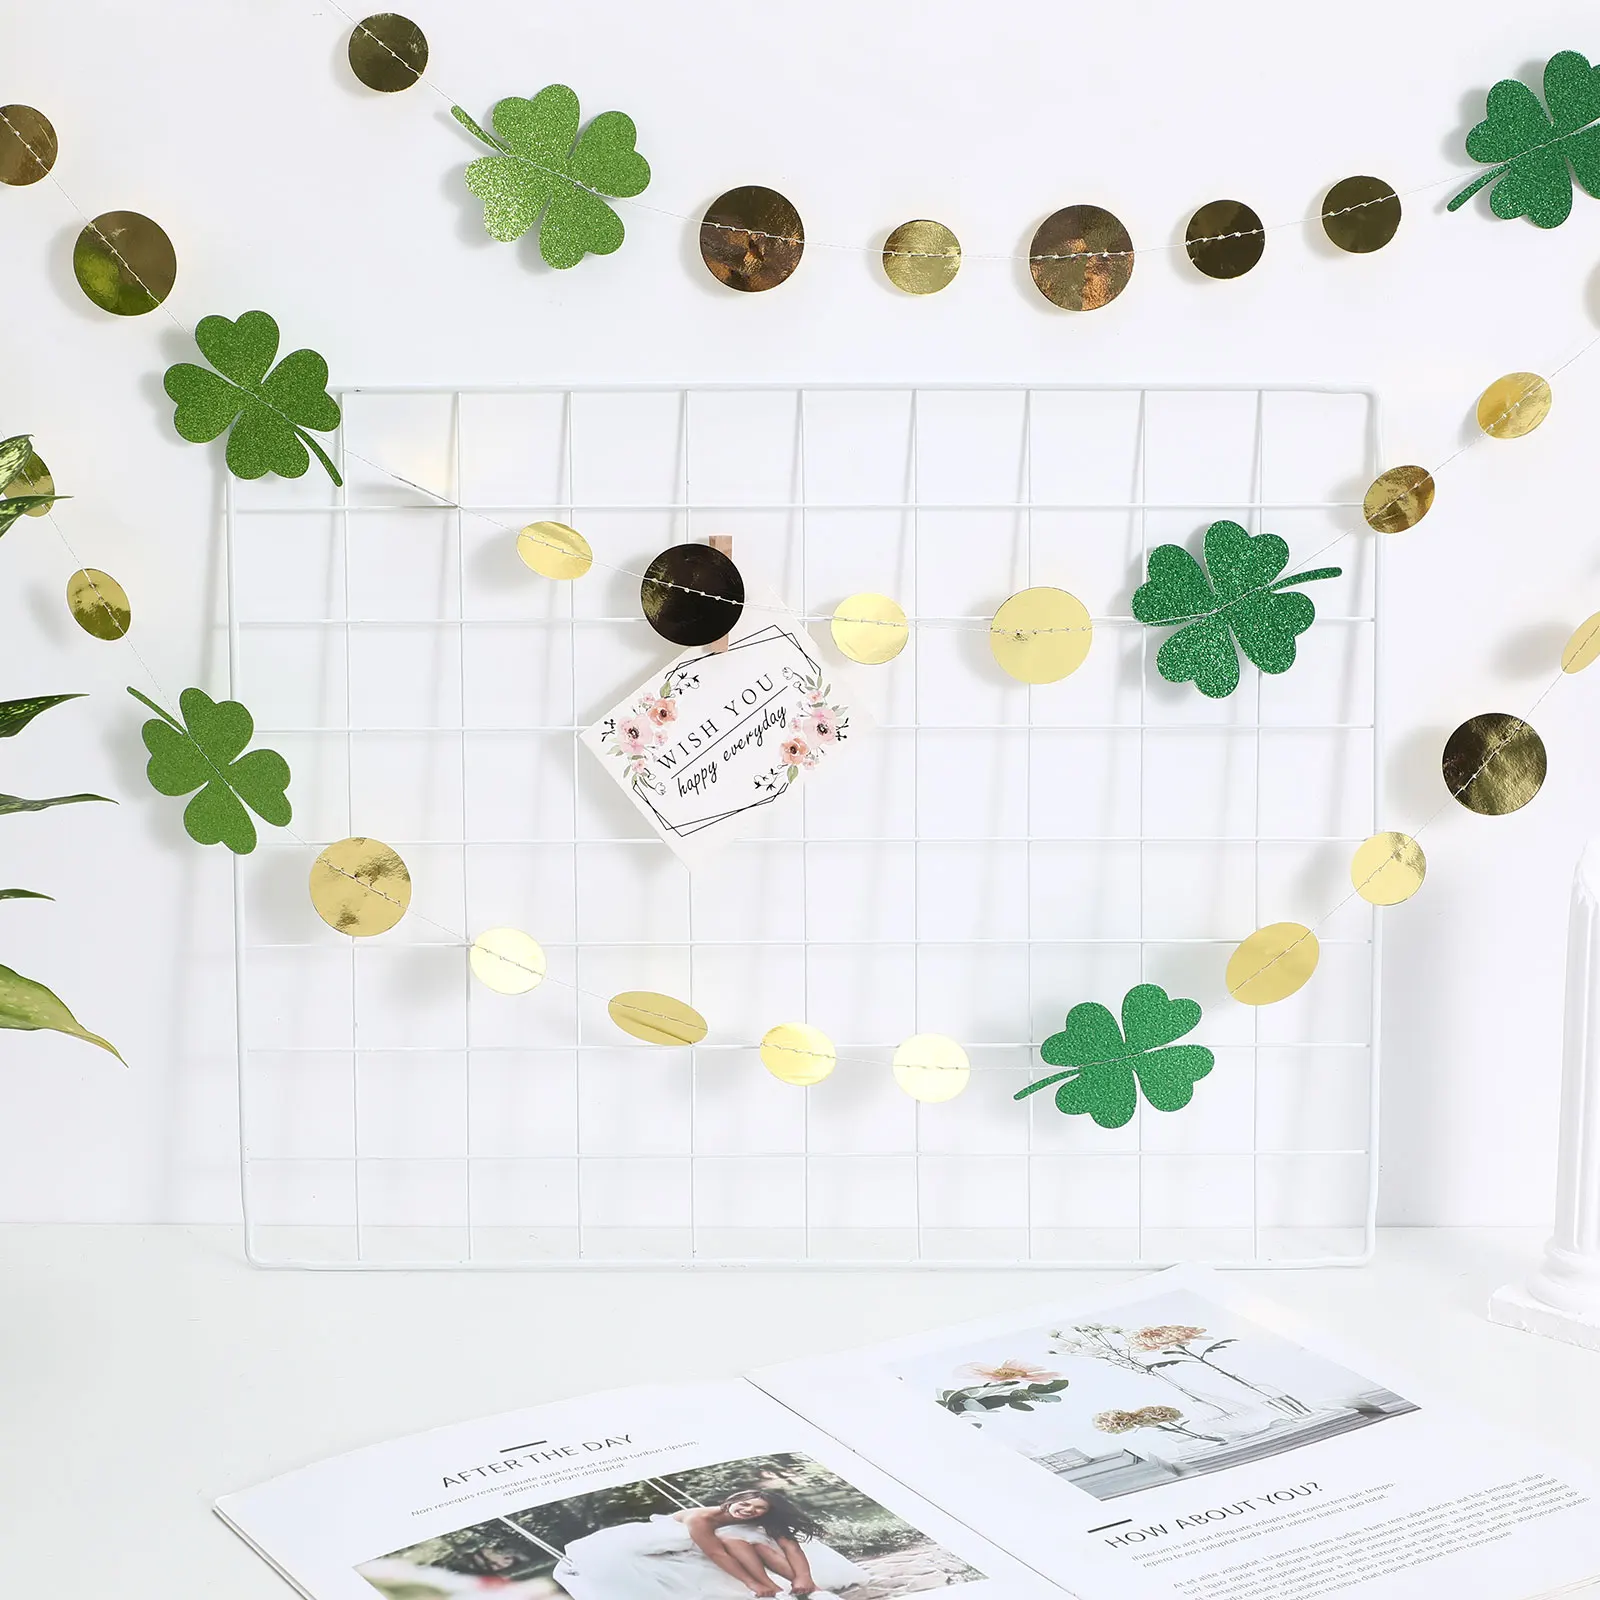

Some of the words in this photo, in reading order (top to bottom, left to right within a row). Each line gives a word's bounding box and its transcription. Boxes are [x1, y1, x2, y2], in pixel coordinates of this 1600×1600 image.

[656, 719, 720, 770] WISH
[723, 673, 775, 718] YOU
[677, 759, 718, 798] happy
[722, 704, 788, 763] everyday
[443, 1459, 523, 1488] AFTER
[523, 1446, 579, 1464] THE
[582, 1434, 632, 1452] DAY
[411, 1507, 433, 1517] Non
[1104, 1524, 1168, 1549] HOW
[1175, 1500, 1256, 1530] ABOUT
[1257, 1482, 1323, 1505] YOU?
